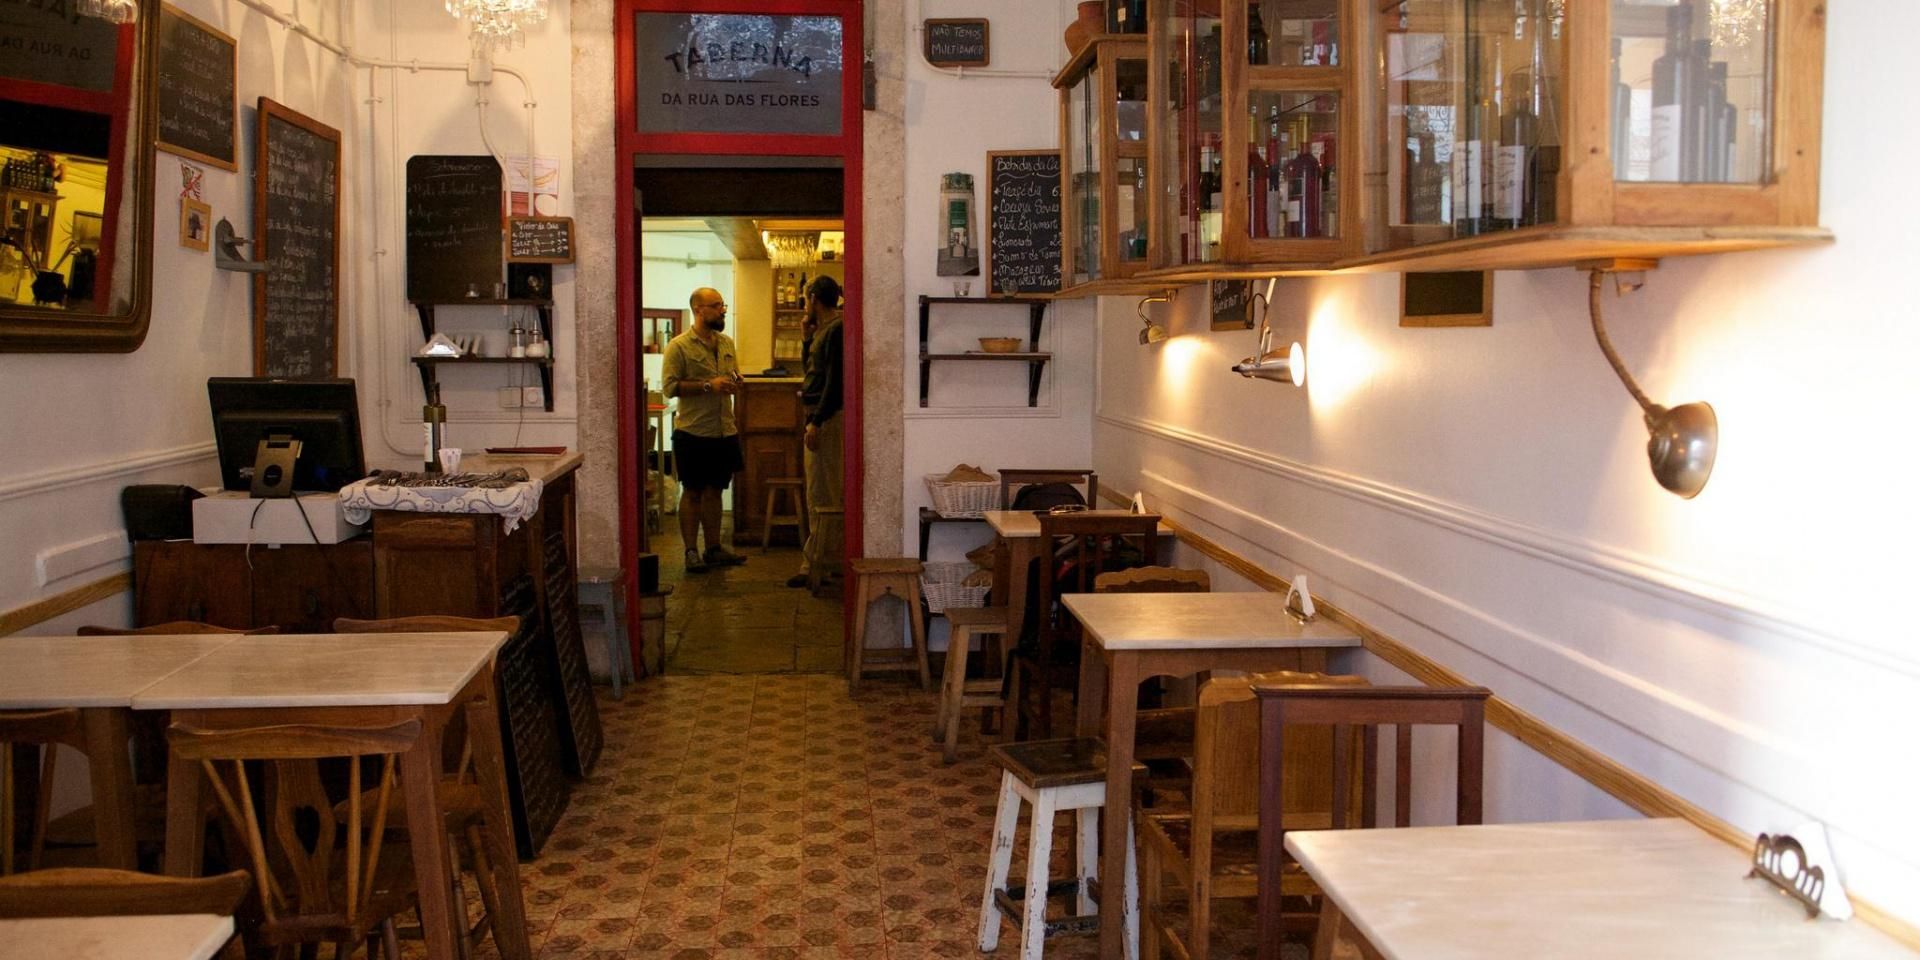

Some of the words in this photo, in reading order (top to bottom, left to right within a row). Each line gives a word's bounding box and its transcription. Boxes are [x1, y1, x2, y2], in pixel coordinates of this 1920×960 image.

[931, 24, 950, 37] NÃO
[954, 26, 982, 40] TEMOS
[664, 41, 812, 77] TABERNA
[662, 93, 682, 105] DA
[688, 93, 719, 105] RUA
[725, 94, 755, 106] DAS
[761, 94, 820, 107] FLORES
